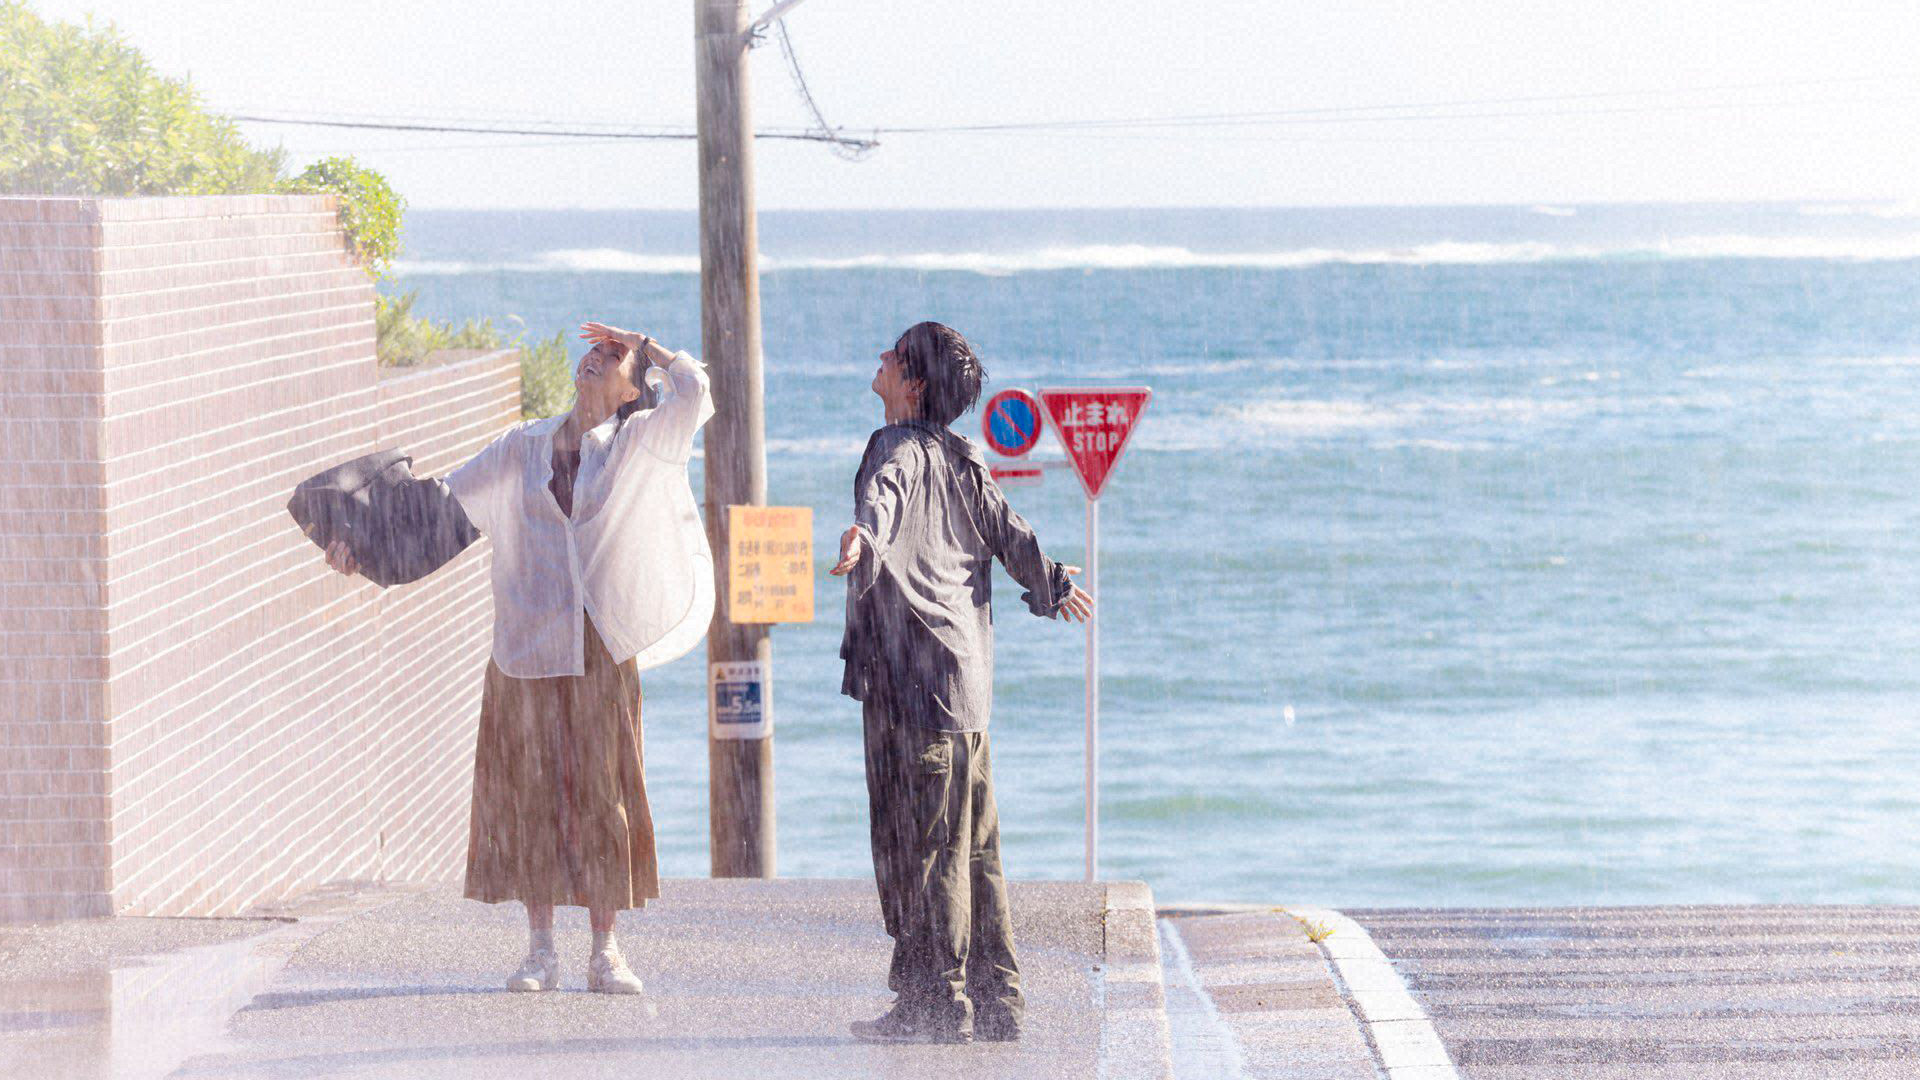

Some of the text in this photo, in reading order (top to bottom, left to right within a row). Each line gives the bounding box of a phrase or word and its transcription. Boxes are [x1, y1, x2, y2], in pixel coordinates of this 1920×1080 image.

[1061, 401, 1129, 427] 止まれ
[1073, 431, 1119, 452] STOP
